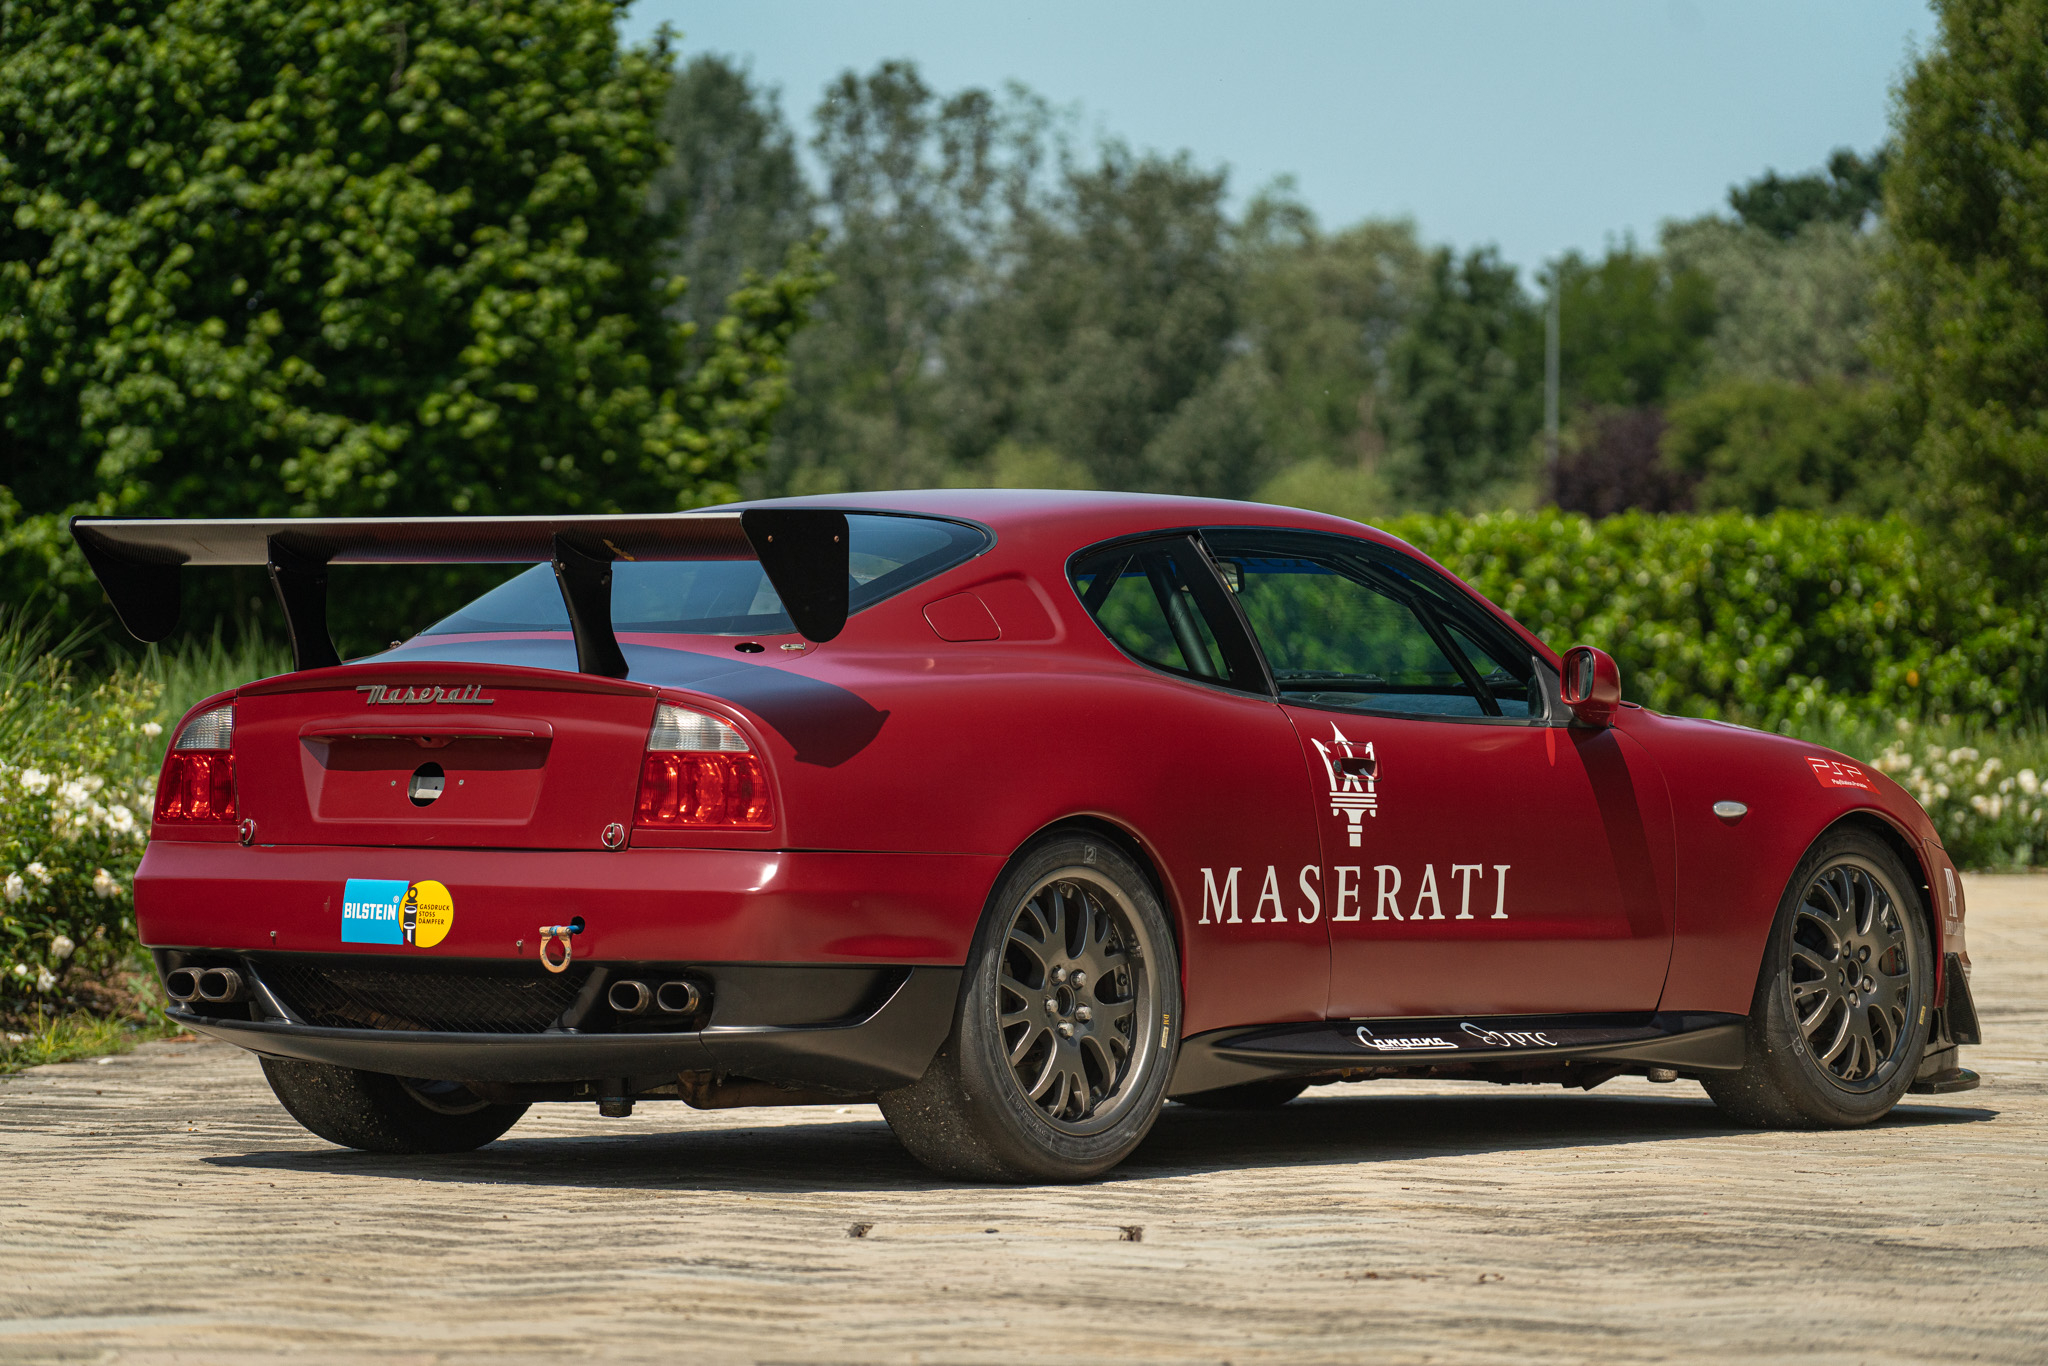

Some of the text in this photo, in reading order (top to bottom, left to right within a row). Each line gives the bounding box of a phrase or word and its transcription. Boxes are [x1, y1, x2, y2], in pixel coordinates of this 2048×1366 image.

[356, 684, 495, 704] Maserati
[1807, 757, 1862, 777] PSP
[1198, 863, 1511, 924] MASERATI
[418, 917, 445, 925] DÄMPFER
[1356, 1026, 1459, 1050] Campana
